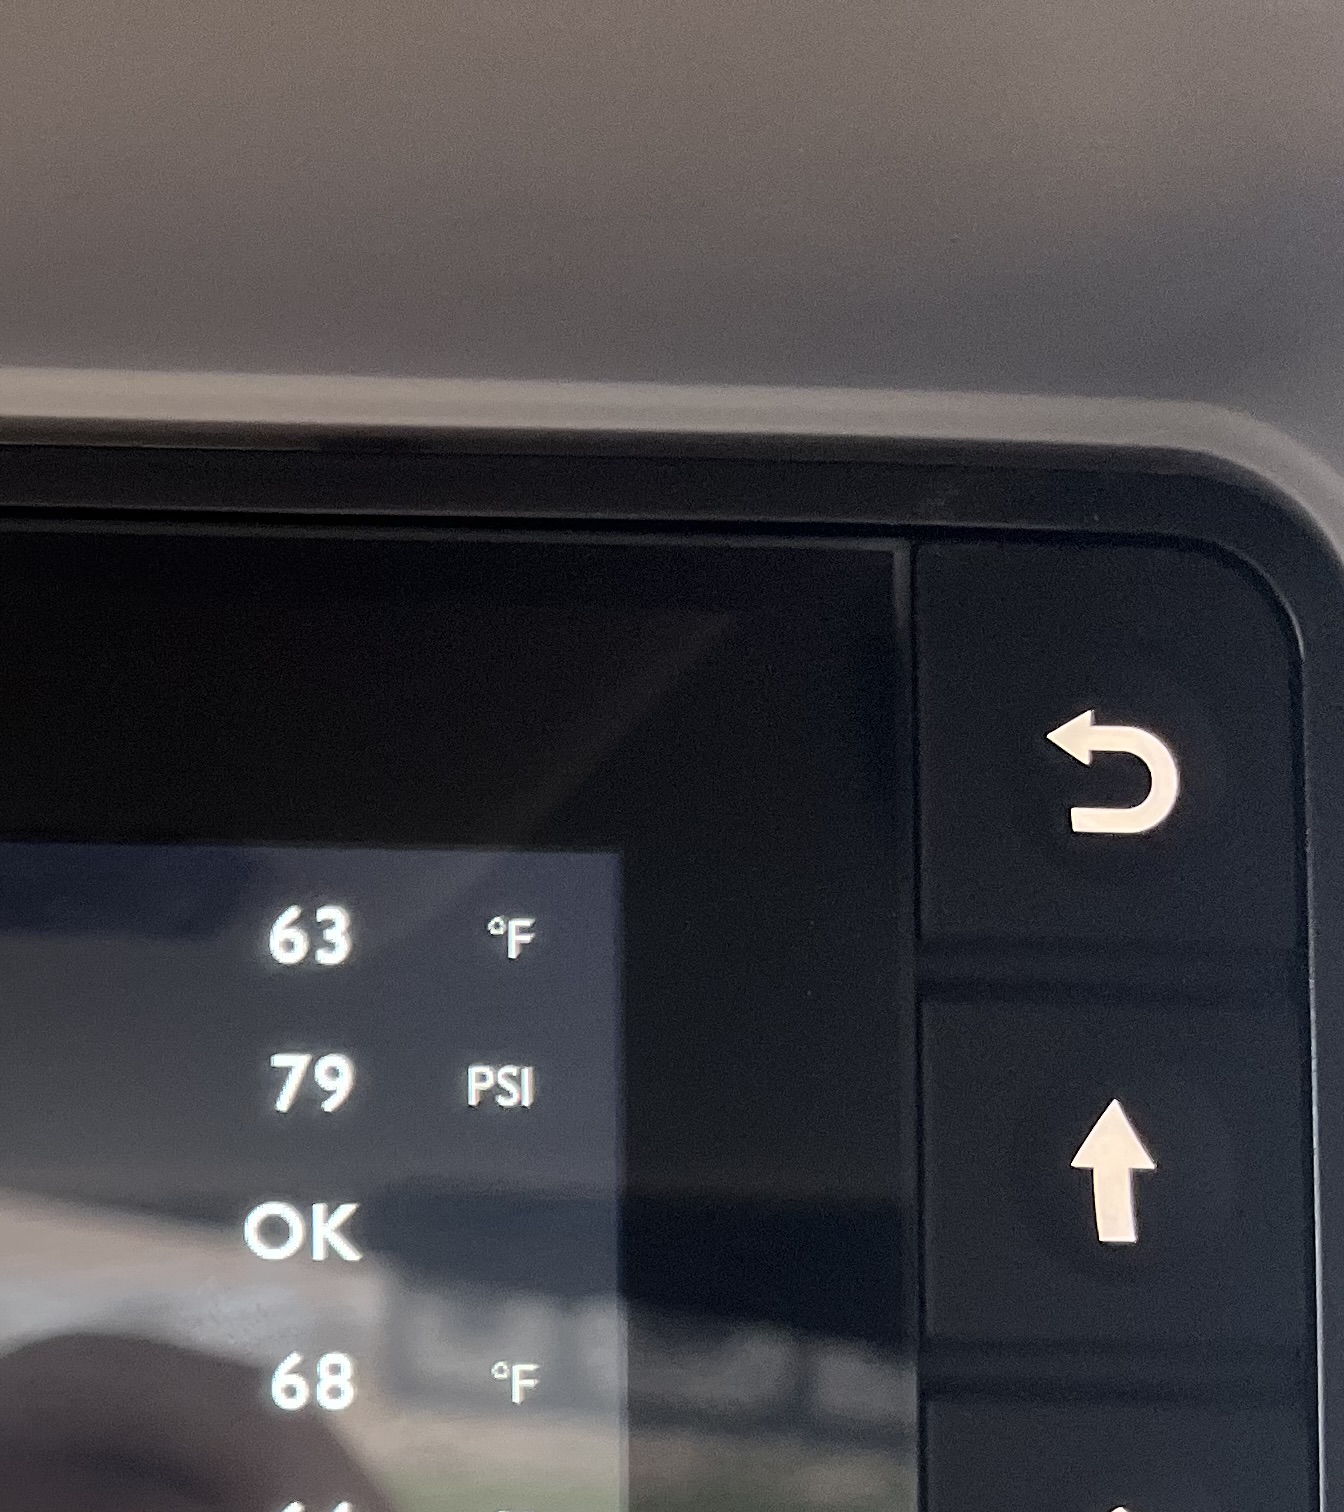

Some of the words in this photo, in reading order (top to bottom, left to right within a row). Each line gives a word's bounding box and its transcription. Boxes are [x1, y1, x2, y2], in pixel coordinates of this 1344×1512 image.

[268, 904, 353, 966] 63
[488, 916, 536, 960] °F
[269, 1053, 354, 1113] 79
[467, 1065, 535, 1109] PSI
[243, 1202, 363, 1263] OK
[270, 1352, 355, 1411] 68
[491, 1361, 540, 1404] °F
